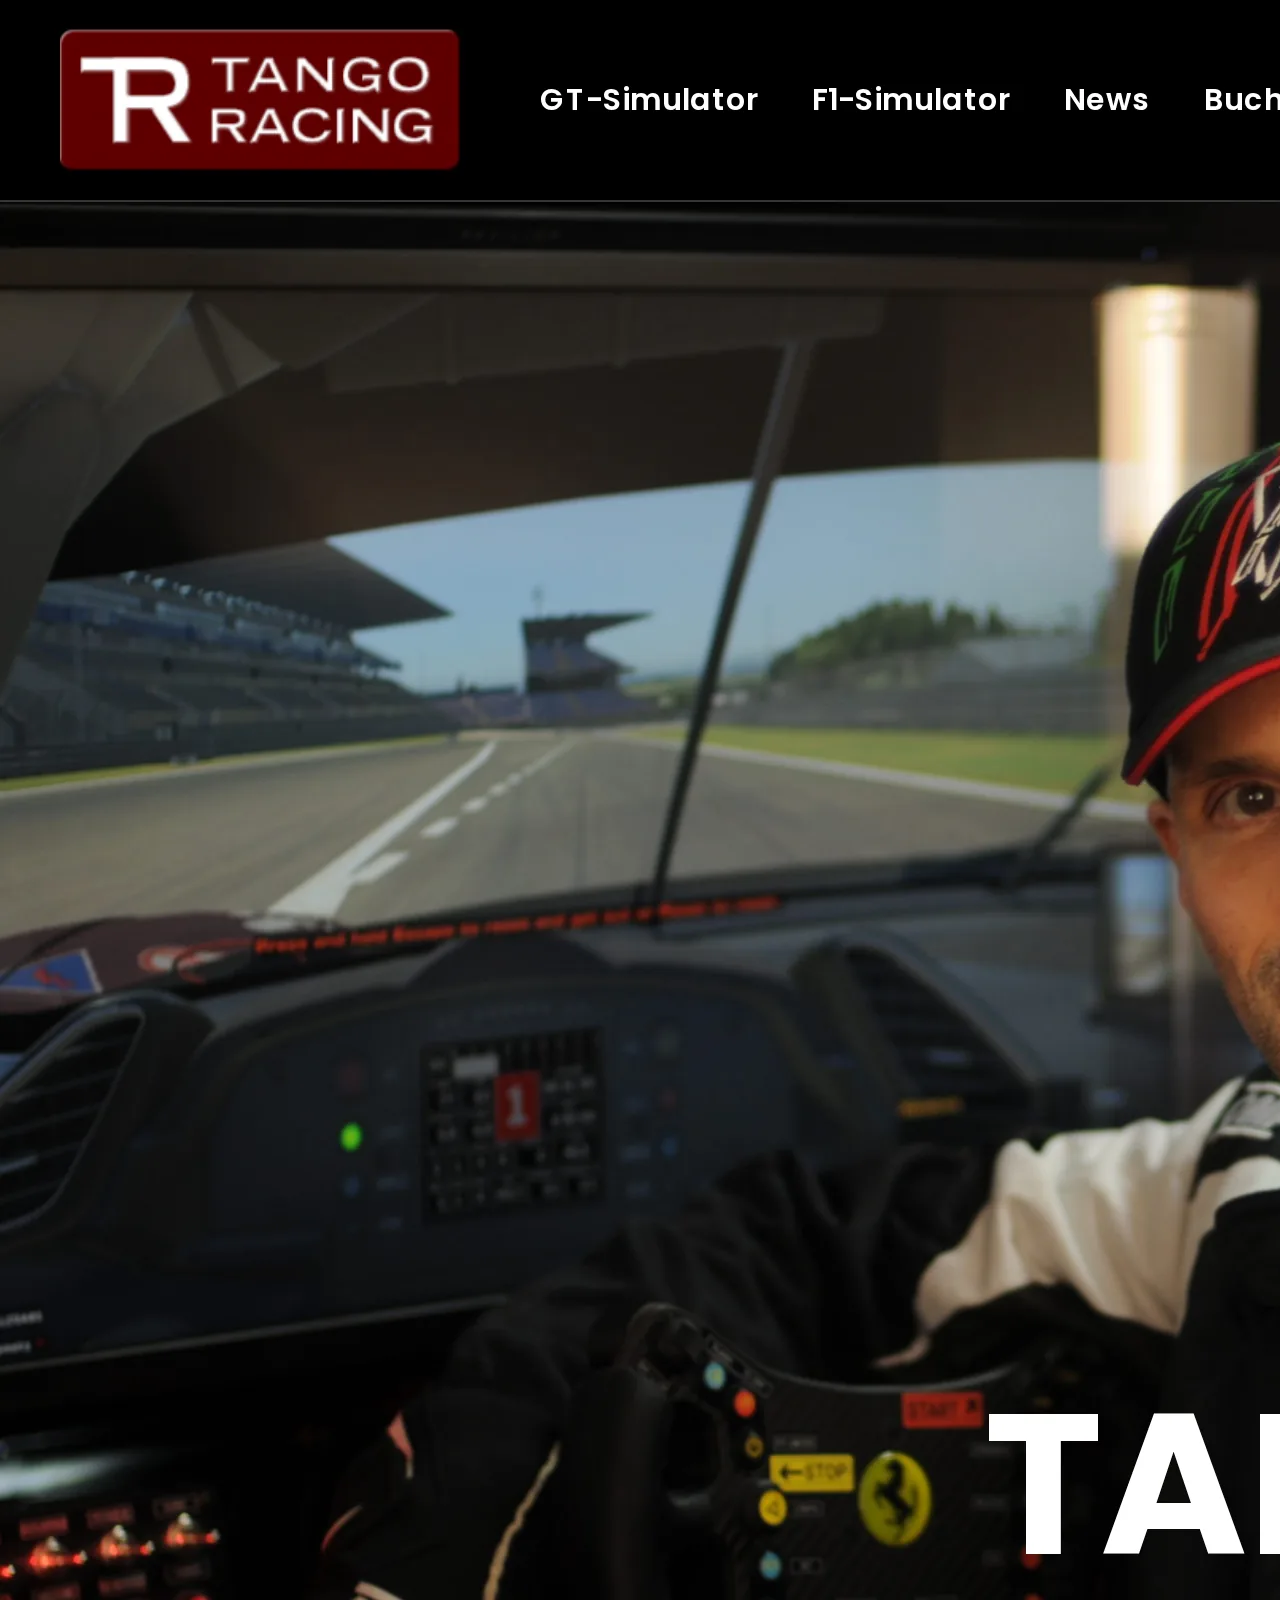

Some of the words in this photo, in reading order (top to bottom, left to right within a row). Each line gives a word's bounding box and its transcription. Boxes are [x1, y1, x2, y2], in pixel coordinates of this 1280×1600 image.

[503, 1082, 530, 1130] 1
[907, 1400, 958, 1420] START
[805, 1463, 847, 1481] STOP
